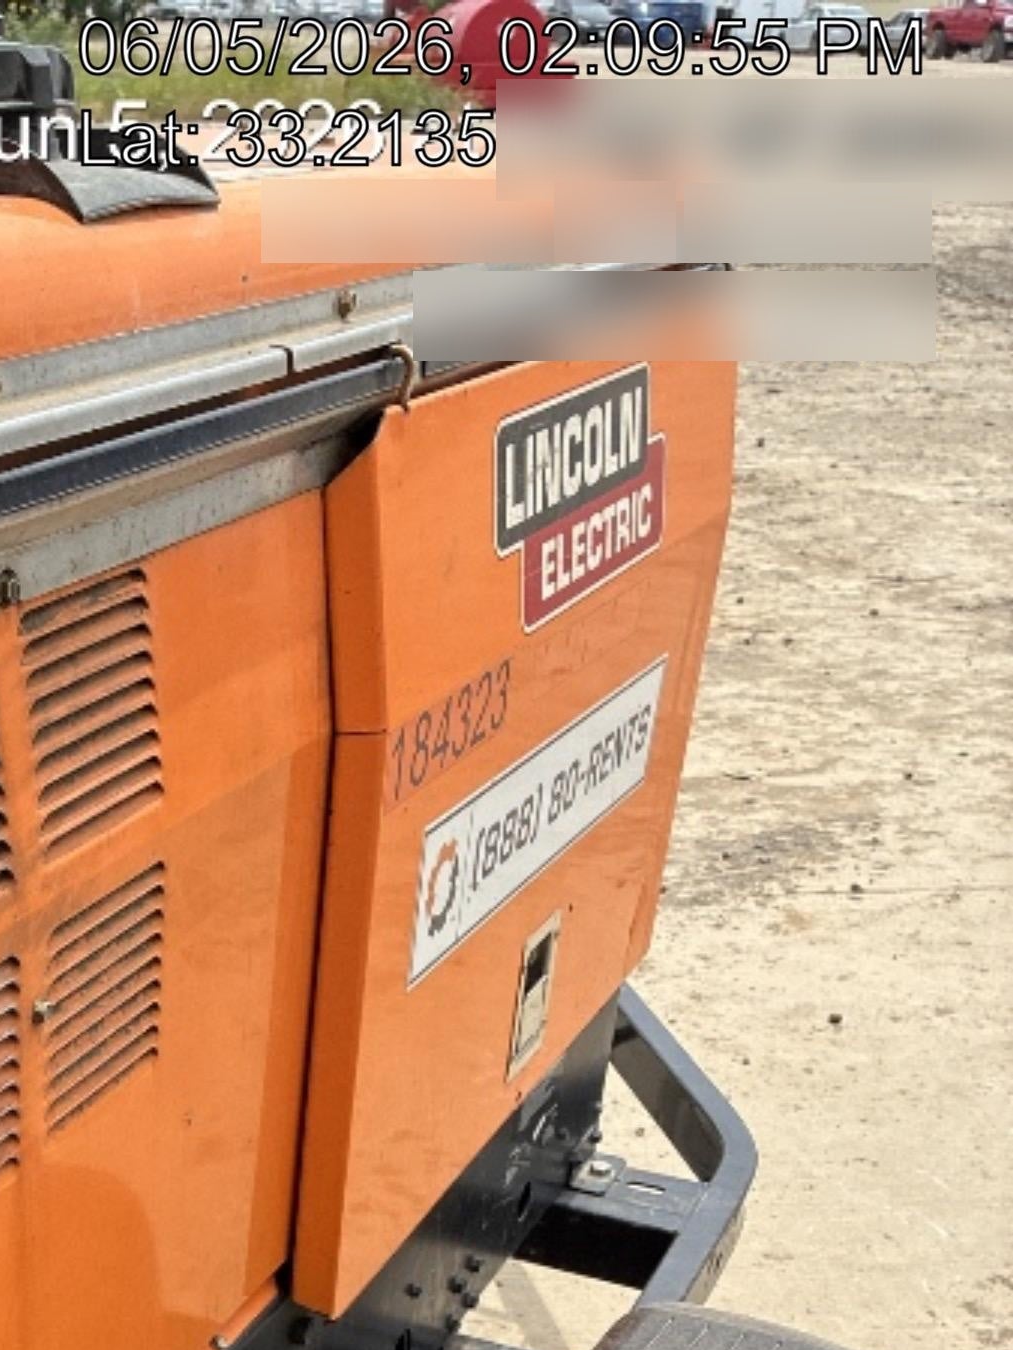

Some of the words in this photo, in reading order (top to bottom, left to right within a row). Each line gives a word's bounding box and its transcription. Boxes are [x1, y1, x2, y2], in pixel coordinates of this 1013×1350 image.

[505, 386, 643, 530] LINCOLN
[541, 483, 653, 601] ELECTRIC
[392, 658, 511, 800] 184323
[471, 783, 543, 891] (888)
[547, 704, 652, 825] 80-RENTS
